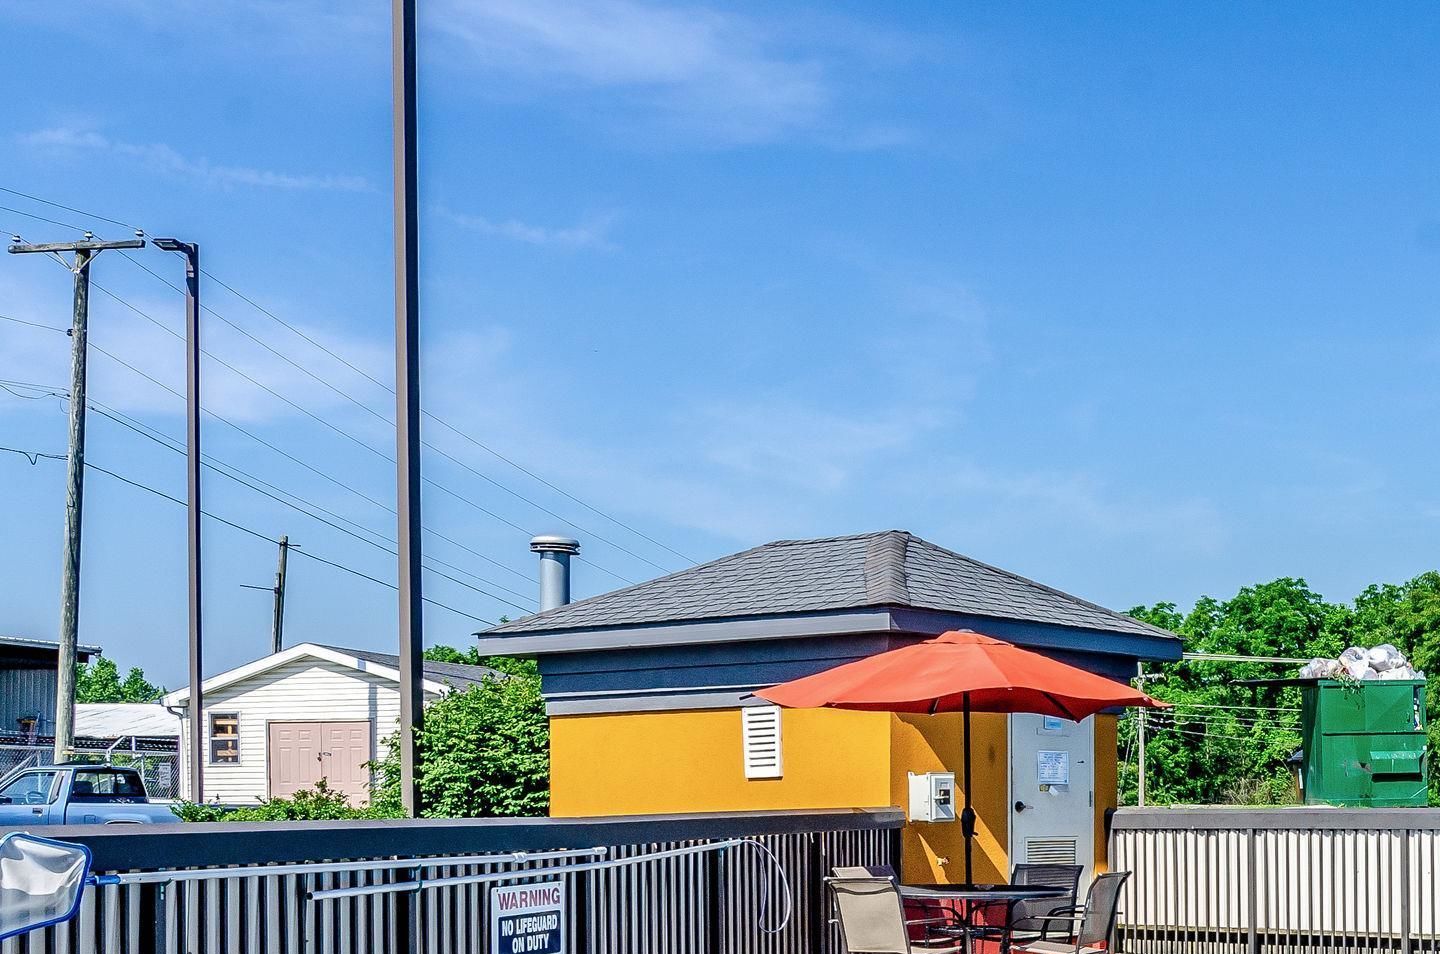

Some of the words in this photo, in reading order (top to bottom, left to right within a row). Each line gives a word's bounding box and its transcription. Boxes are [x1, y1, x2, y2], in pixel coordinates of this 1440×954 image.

[498, 887, 561, 910] WARNING
[502, 919, 514, 937] NO
[516, 914, 558, 934] LIFEGUARD
[512, 936, 525, 954] ON
[527, 933, 550, 952] DUTY
